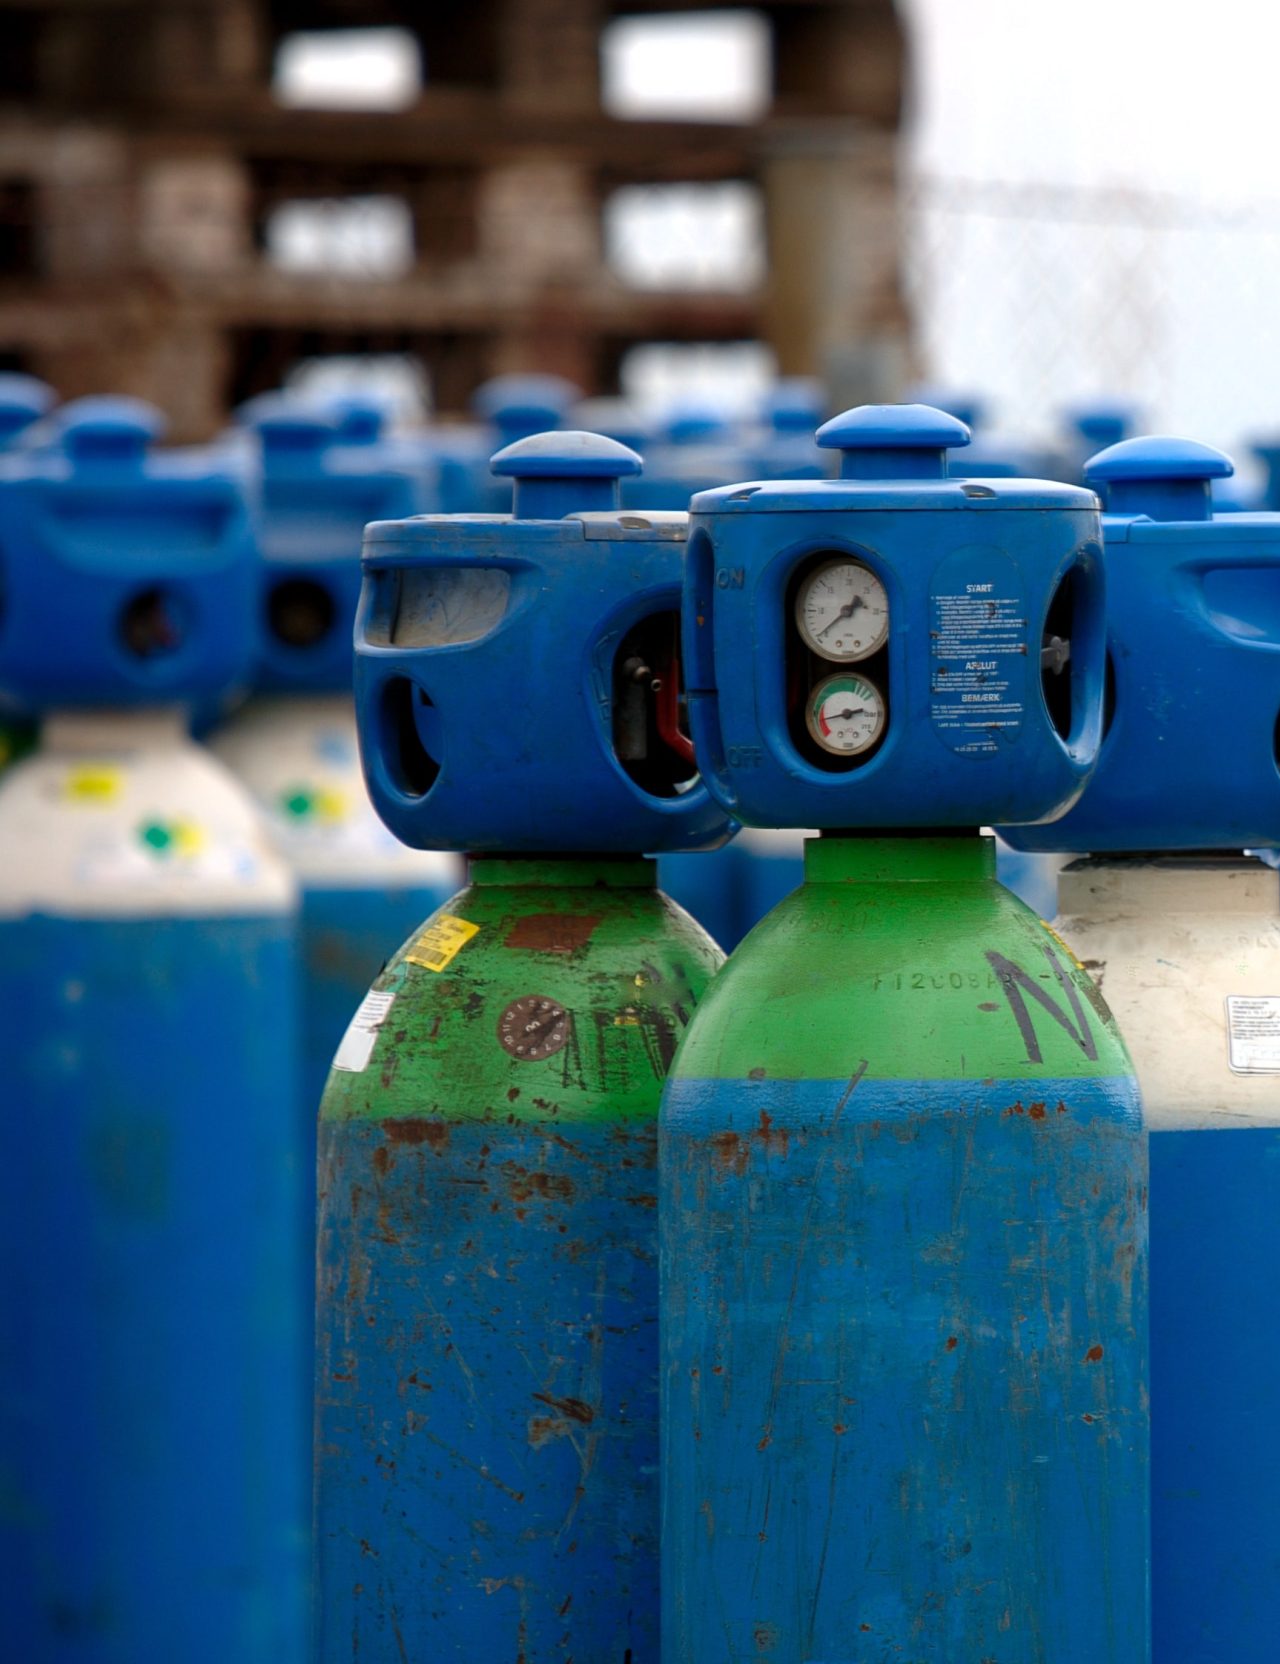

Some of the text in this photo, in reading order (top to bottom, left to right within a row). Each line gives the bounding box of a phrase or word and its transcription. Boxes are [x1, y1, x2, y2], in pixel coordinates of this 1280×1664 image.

[716, 567, 744, 589] ON
[966, 584, 993, 593] START
[983, 944, 1099, 1064] N
